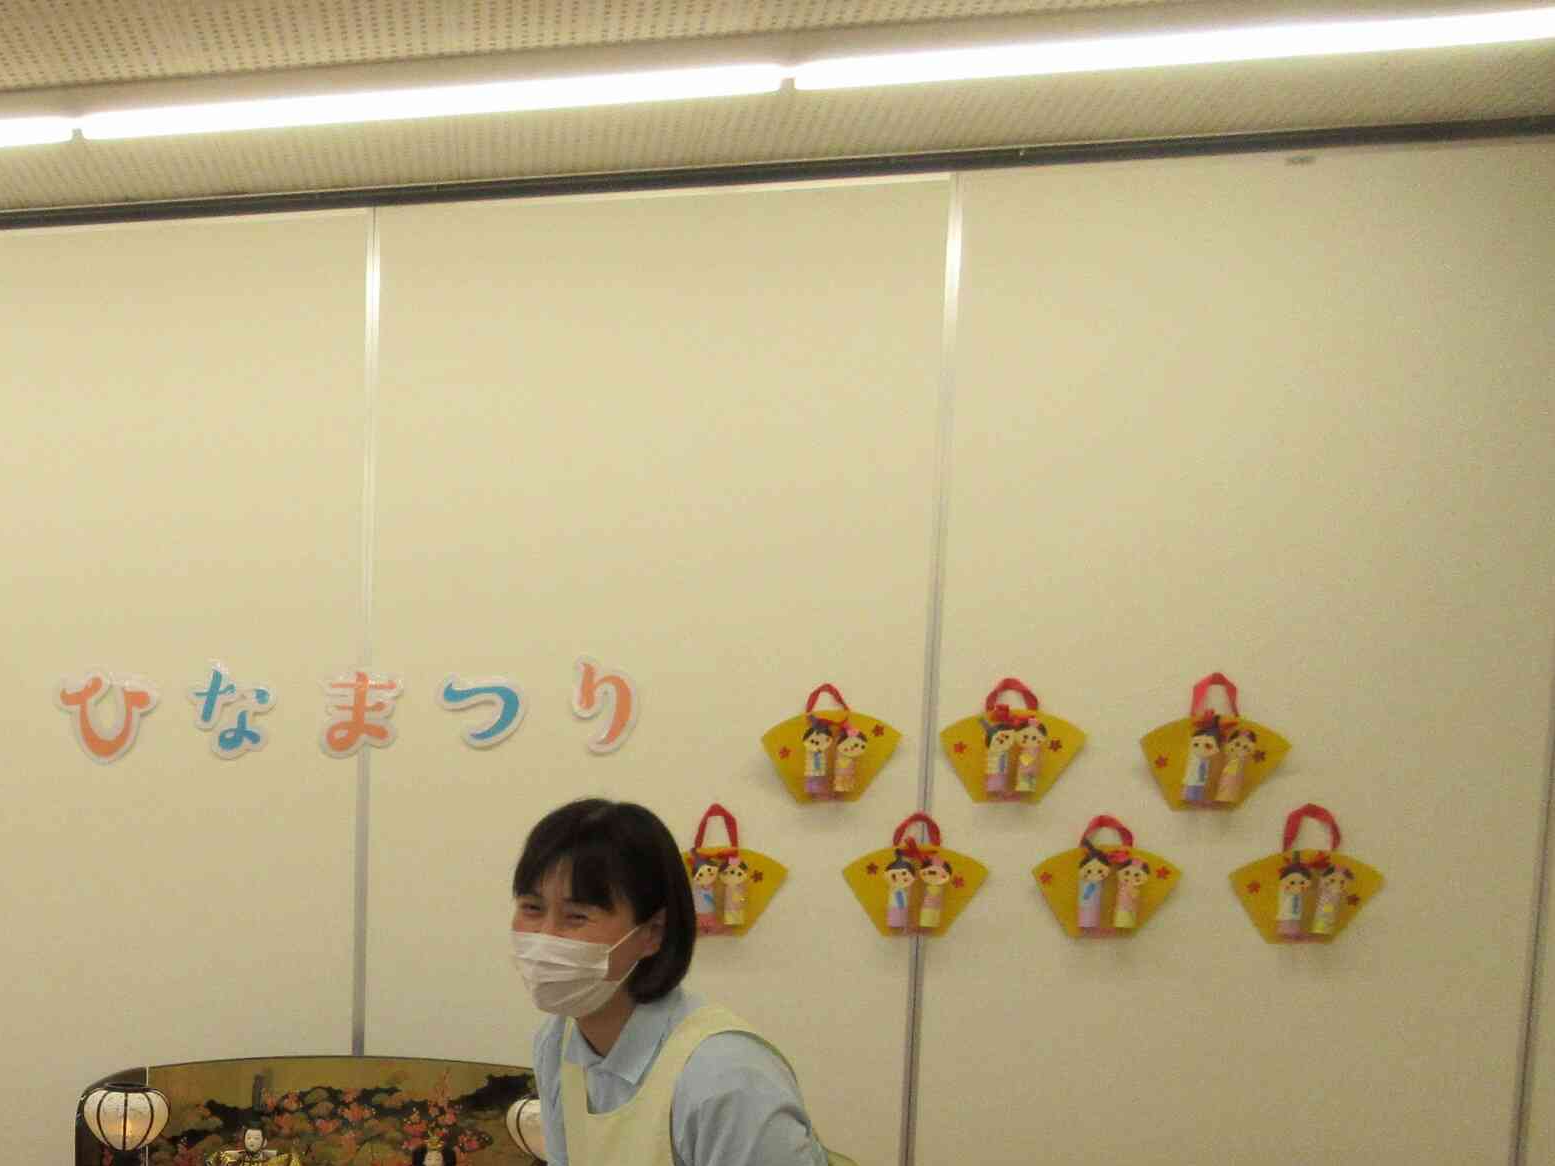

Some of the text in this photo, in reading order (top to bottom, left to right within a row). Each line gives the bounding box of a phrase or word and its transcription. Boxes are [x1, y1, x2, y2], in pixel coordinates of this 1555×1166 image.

[59, 659, 640, 757] ひなまつり
